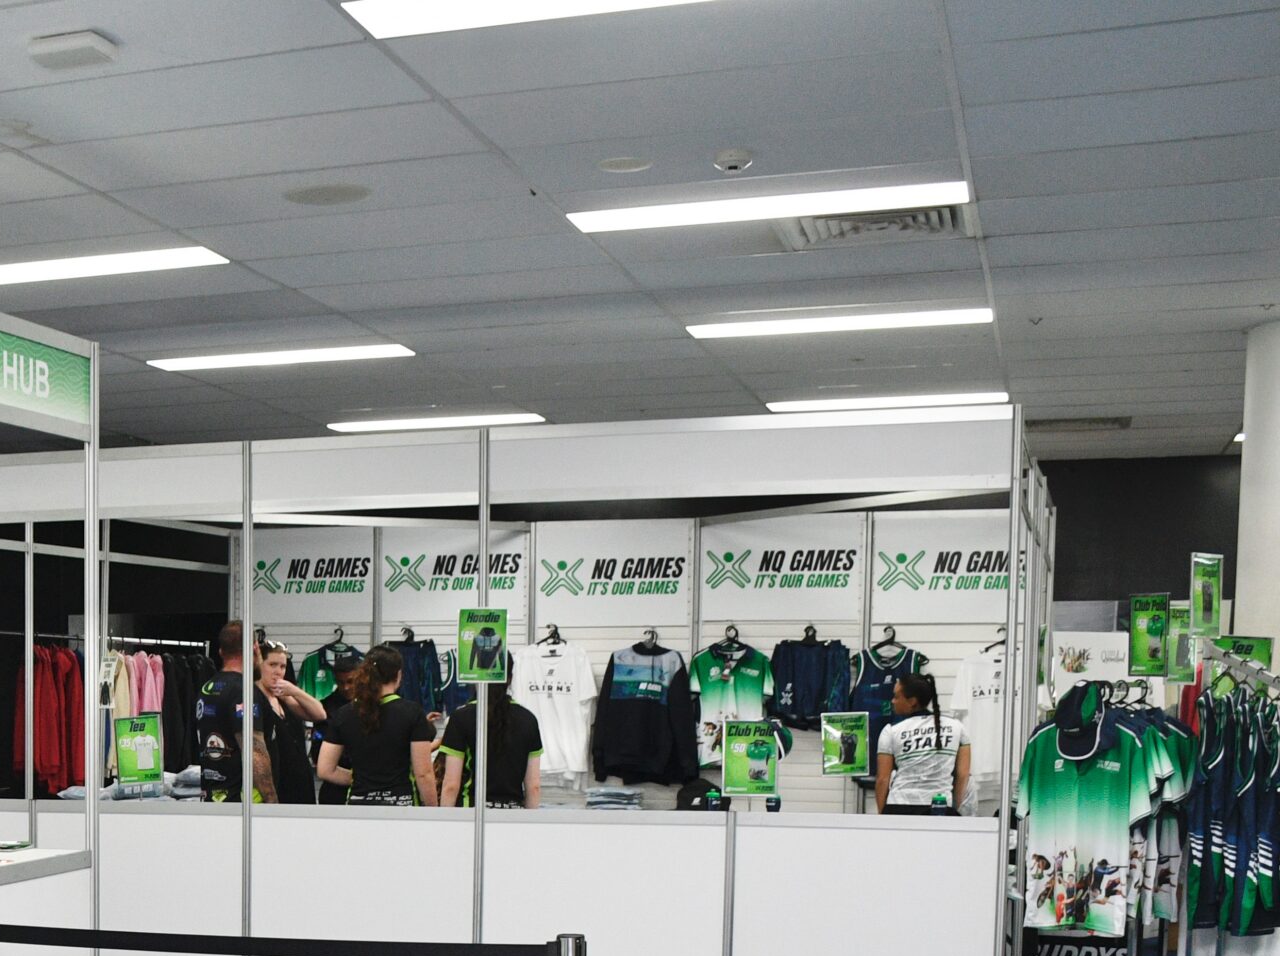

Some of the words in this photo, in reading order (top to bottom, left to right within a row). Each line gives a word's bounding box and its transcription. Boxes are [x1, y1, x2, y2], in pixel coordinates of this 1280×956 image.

[3, 350, 50, 398] HUB
[287, 559, 312, 580] NQ
[317, 557, 370, 578] GAMES
[433, 554, 458, 577] NQ
[591, 559, 617, 580] NQ
[621, 557, 686, 579] GAMES
[759, 550, 784, 574] NQ
[789, 549, 856, 572] GAMES
[933, 551, 962, 574] NQ
[966, 551, 1025, 573] GAM
[283, 580, 303, 594] IT'S
[305, 580, 326, 593] OUR
[328, 579, 365, 593] GAMES
[429, 579, 449, 592] IT'S
[452, 578, 474, 591] OUR
[477, 576, 516, 591] MES
[587, 581, 608, 596] IT'S
[611, 581, 634, 596] OUR
[637, 580, 679, 595] GAMES
[754, 575, 776, 589] IT'S
[779, 574, 804, 588] OUR
[807, 573, 849, 588] GAMES
[928, 576, 952, 590] IT'S
[955, 575, 981, 590] OUR
[984, 575, 1025, 590] GAM
[467, 612, 500, 623] Hoodie
[1232, 641, 1254, 656] Tee
[972, 688, 1018, 698] CAIRS
[129, 721, 146, 733] Tee
[728, 725, 751, 737] Club
[901, 725, 953, 739] STRUDYS
